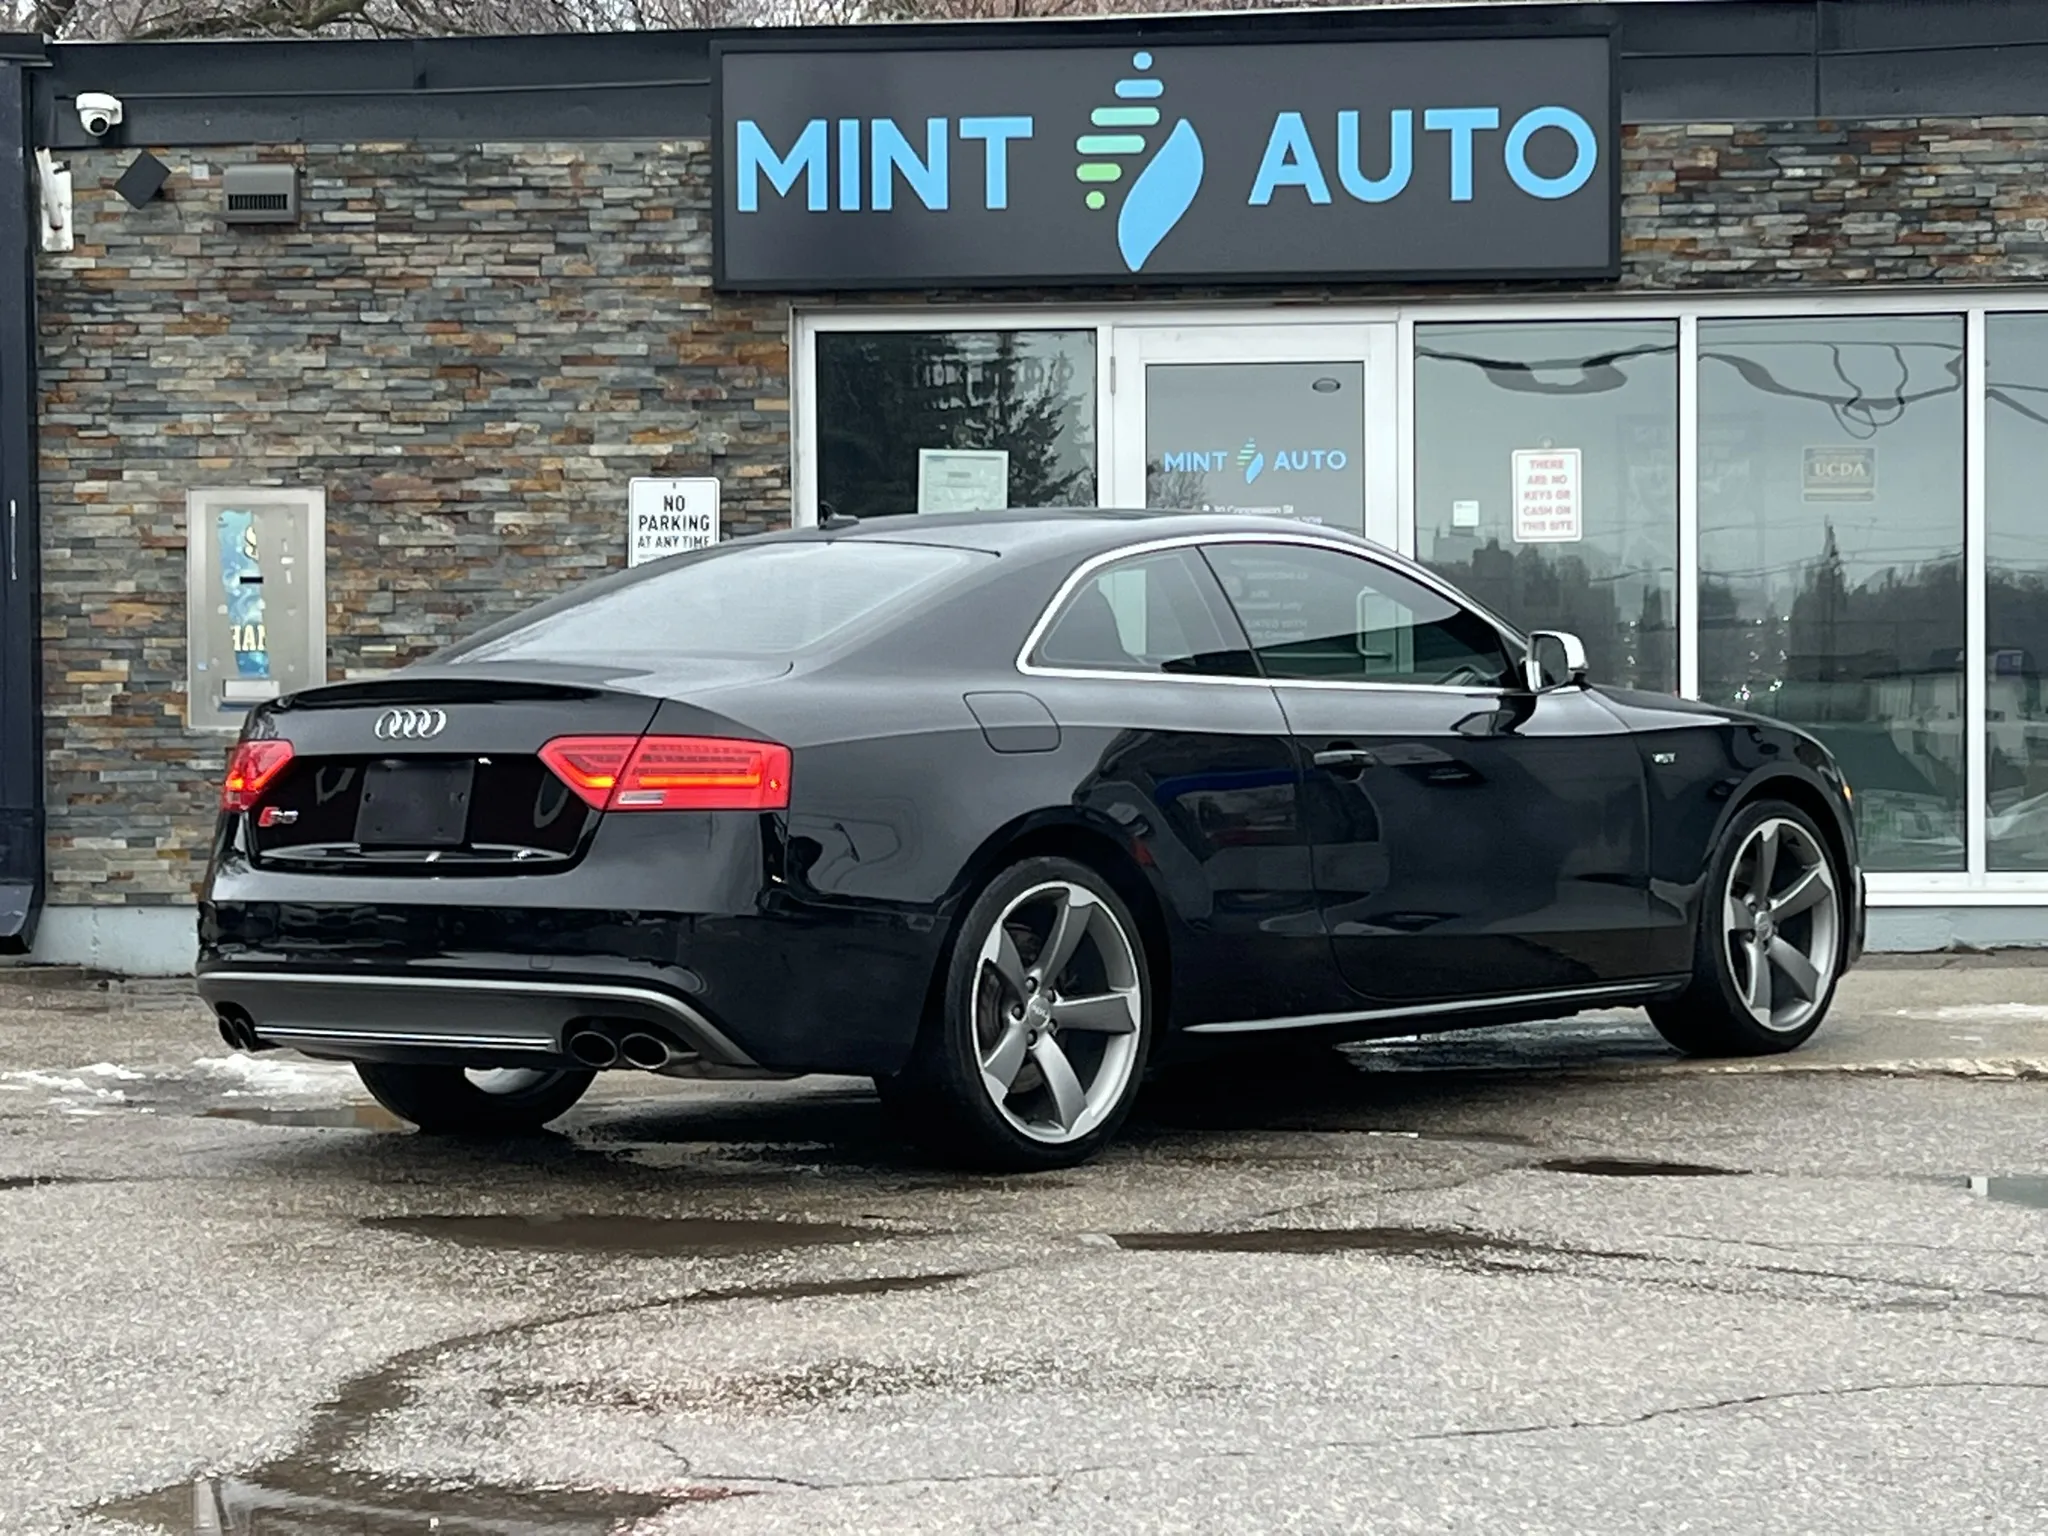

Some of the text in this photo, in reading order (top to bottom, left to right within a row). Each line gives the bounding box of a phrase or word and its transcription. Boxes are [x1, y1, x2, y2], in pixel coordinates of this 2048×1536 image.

[736, 106, 1598, 212] MINT AUTO
[1163, 449, 1347, 473] MINT AUTO
[1529, 459, 1564, 470] THERE
[1815, 462, 1866, 477] UCDA
[1527, 474, 1567, 485] ARE NO
[1524, 490, 1570, 500] KEYS OR
[663, 495, 686, 512] NO
[1523, 504, 1571, 516] CASH ON
[638, 514, 710, 532] PARKING
[1522, 520, 1573, 531] THIS SITE
[637, 535, 711, 549] AT ANY TIME
